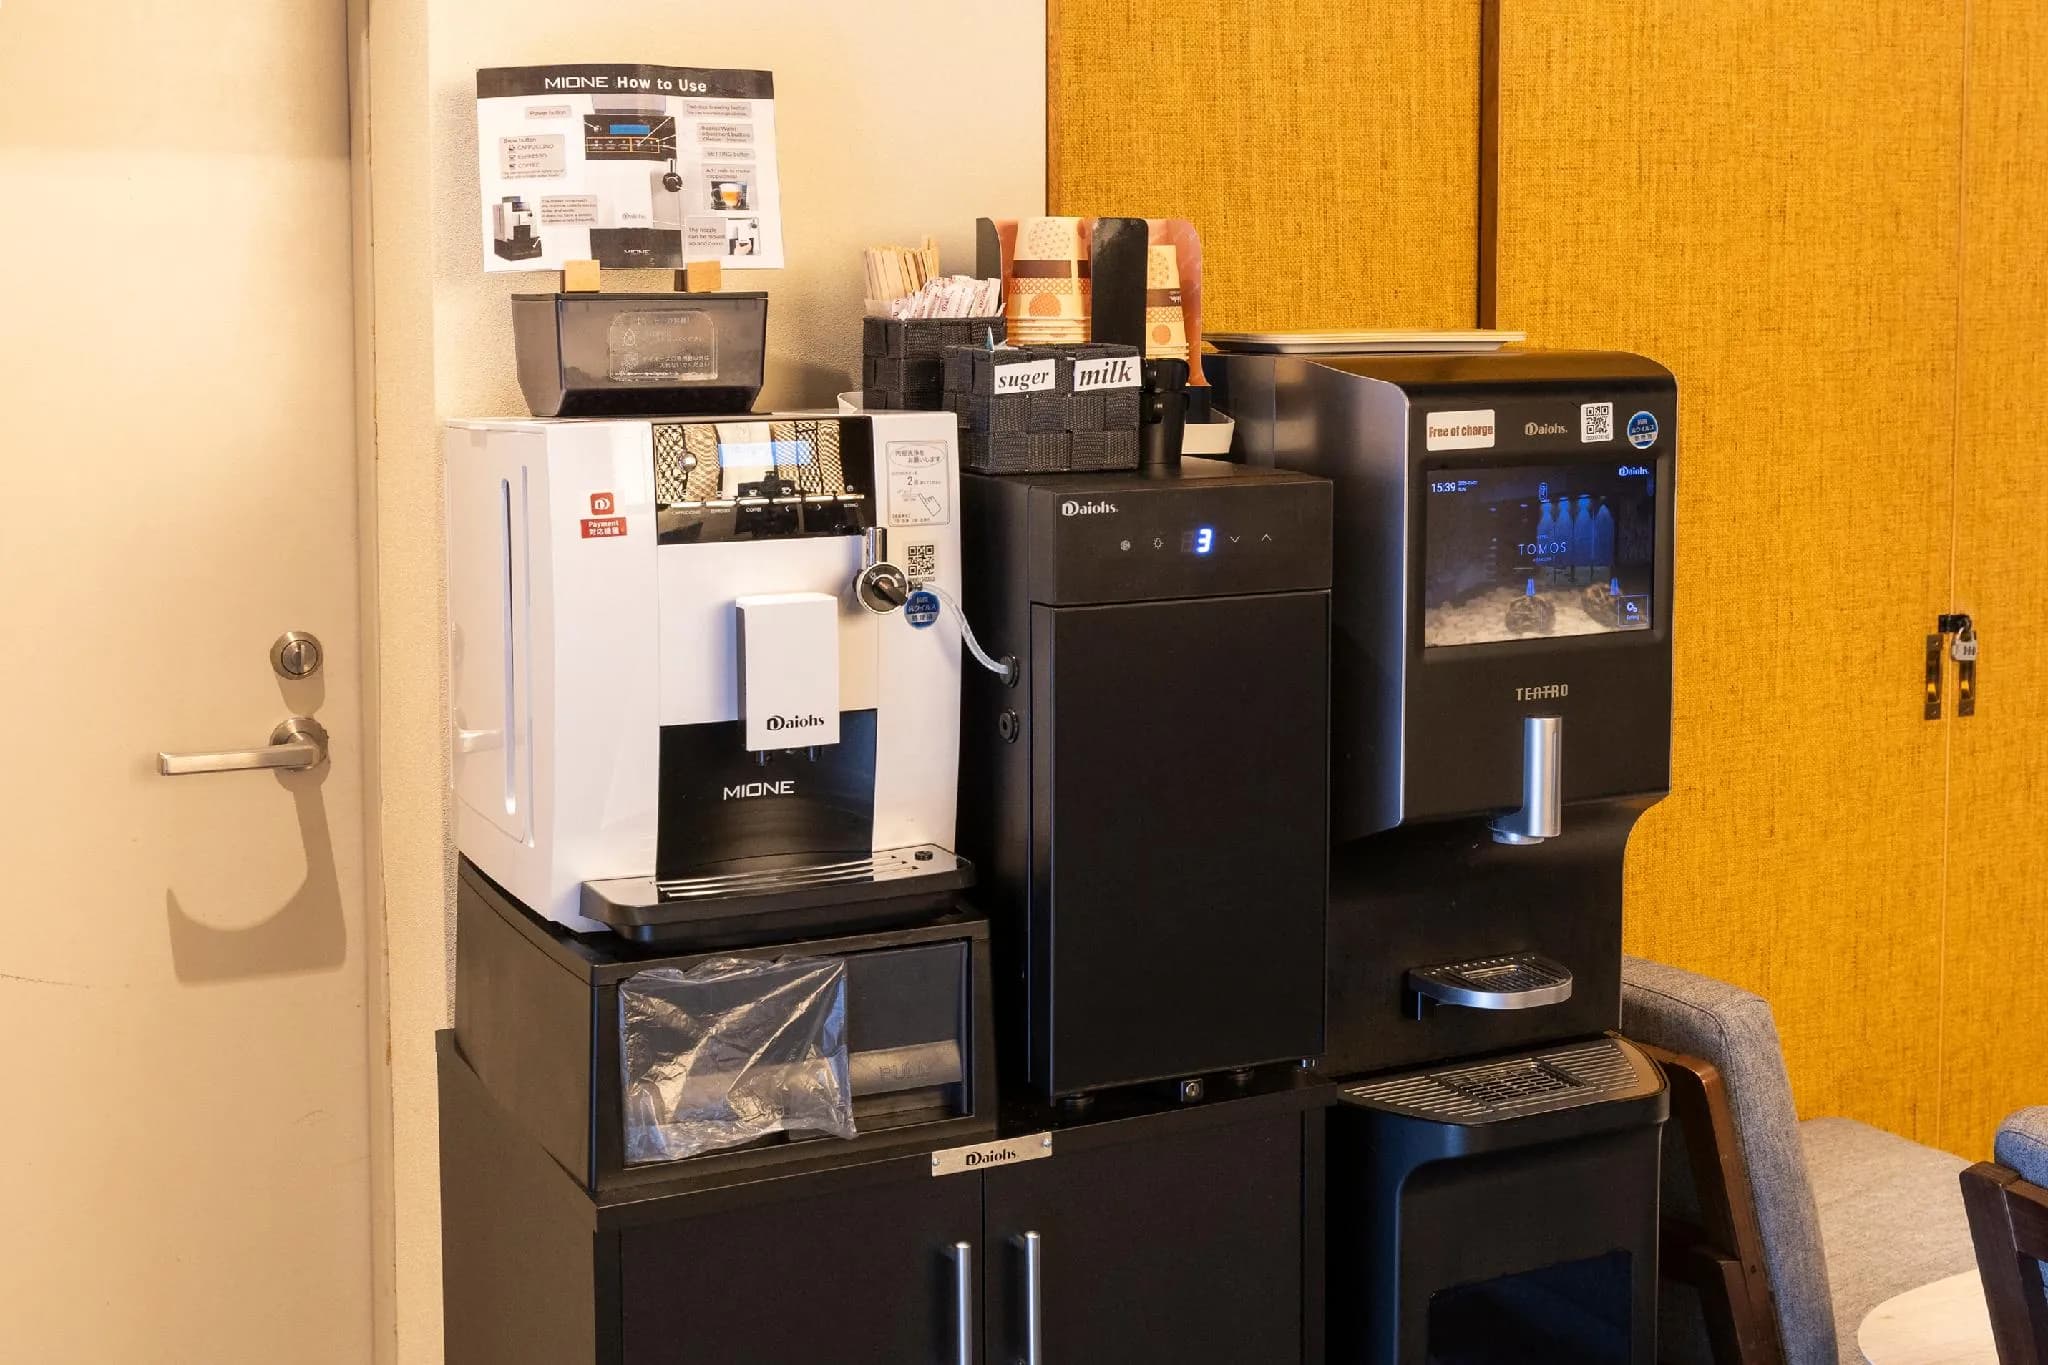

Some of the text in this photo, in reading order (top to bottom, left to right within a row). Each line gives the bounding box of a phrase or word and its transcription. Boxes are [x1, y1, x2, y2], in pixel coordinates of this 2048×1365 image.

[544, 76, 707, 92] MIONE How to Use
[998, 372, 1049, 390] suger
[1079, 361, 1133, 386] milk
[1429, 425, 1493, 438] Free of charge
[588, 520, 619, 529] Payment
[1197, 528, 1212, 552] 3
[1518, 542, 1567, 556] TOMOS
[1516, 683, 1568, 701] TEATRO
[767, 715, 825, 730] Daiohs
[723, 781, 795, 800] MIONE
[966, 1149, 1016, 1165] Daiohs
